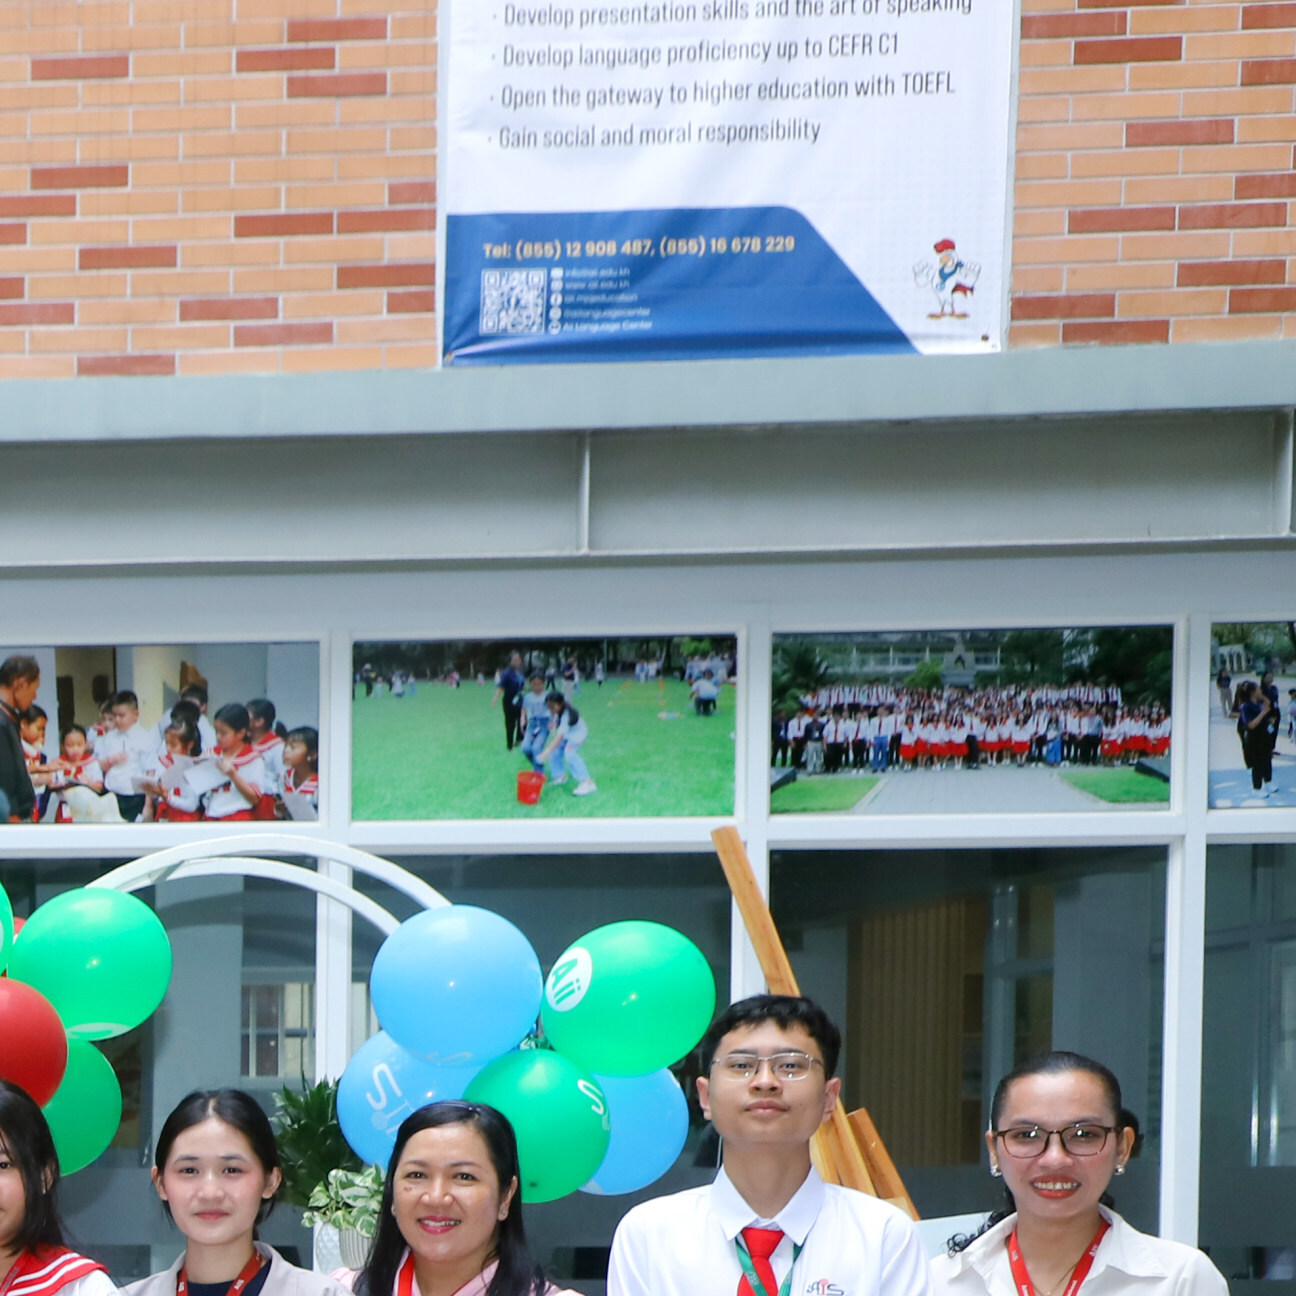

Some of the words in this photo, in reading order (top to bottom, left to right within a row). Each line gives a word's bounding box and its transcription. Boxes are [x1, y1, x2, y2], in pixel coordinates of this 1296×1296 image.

[504, 3, 574, 29] Develop
[579, 1, 696, 30] presentation
[702, 0, 749, 22] skills
[755, 0, 789, 18] and
[795, 0, 824, 17] the
[830, 0, 856, 16] art
[503, 43, 573, 69] Develop
[579, 44, 661, 70] language
[667, 39, 771, 67] proficiency
[776, 41, 798, 63] up
[805, 38, 822, 58] to
[828, 33, 873, 57] CEFR
[879, 32, 899, 55] C1
[502, 84, 546, 111] Open
[552, 84, 581, 107] the
[586, 84, 664, 110] gateway
[669, 83, 688, 104] to
[693, 78, 752, 106] higher
[757, 77, 849, 101] education
[855, 74, 895, 97] with
[901, 71, 956, 96] TOEFL
[499, 125, 537, 149] Gain
[543, 124, 595, 148] social
[601, 123, 634, 146] and
[639, 121, 691, 145] moral
[698, 117, 821, 145] responsibility
[565, 241, 581, 257] 12
[660, 236, 705, 258] (855)
[710, 238, 726, 253] 16
[765, 236, 795, 252] 229
